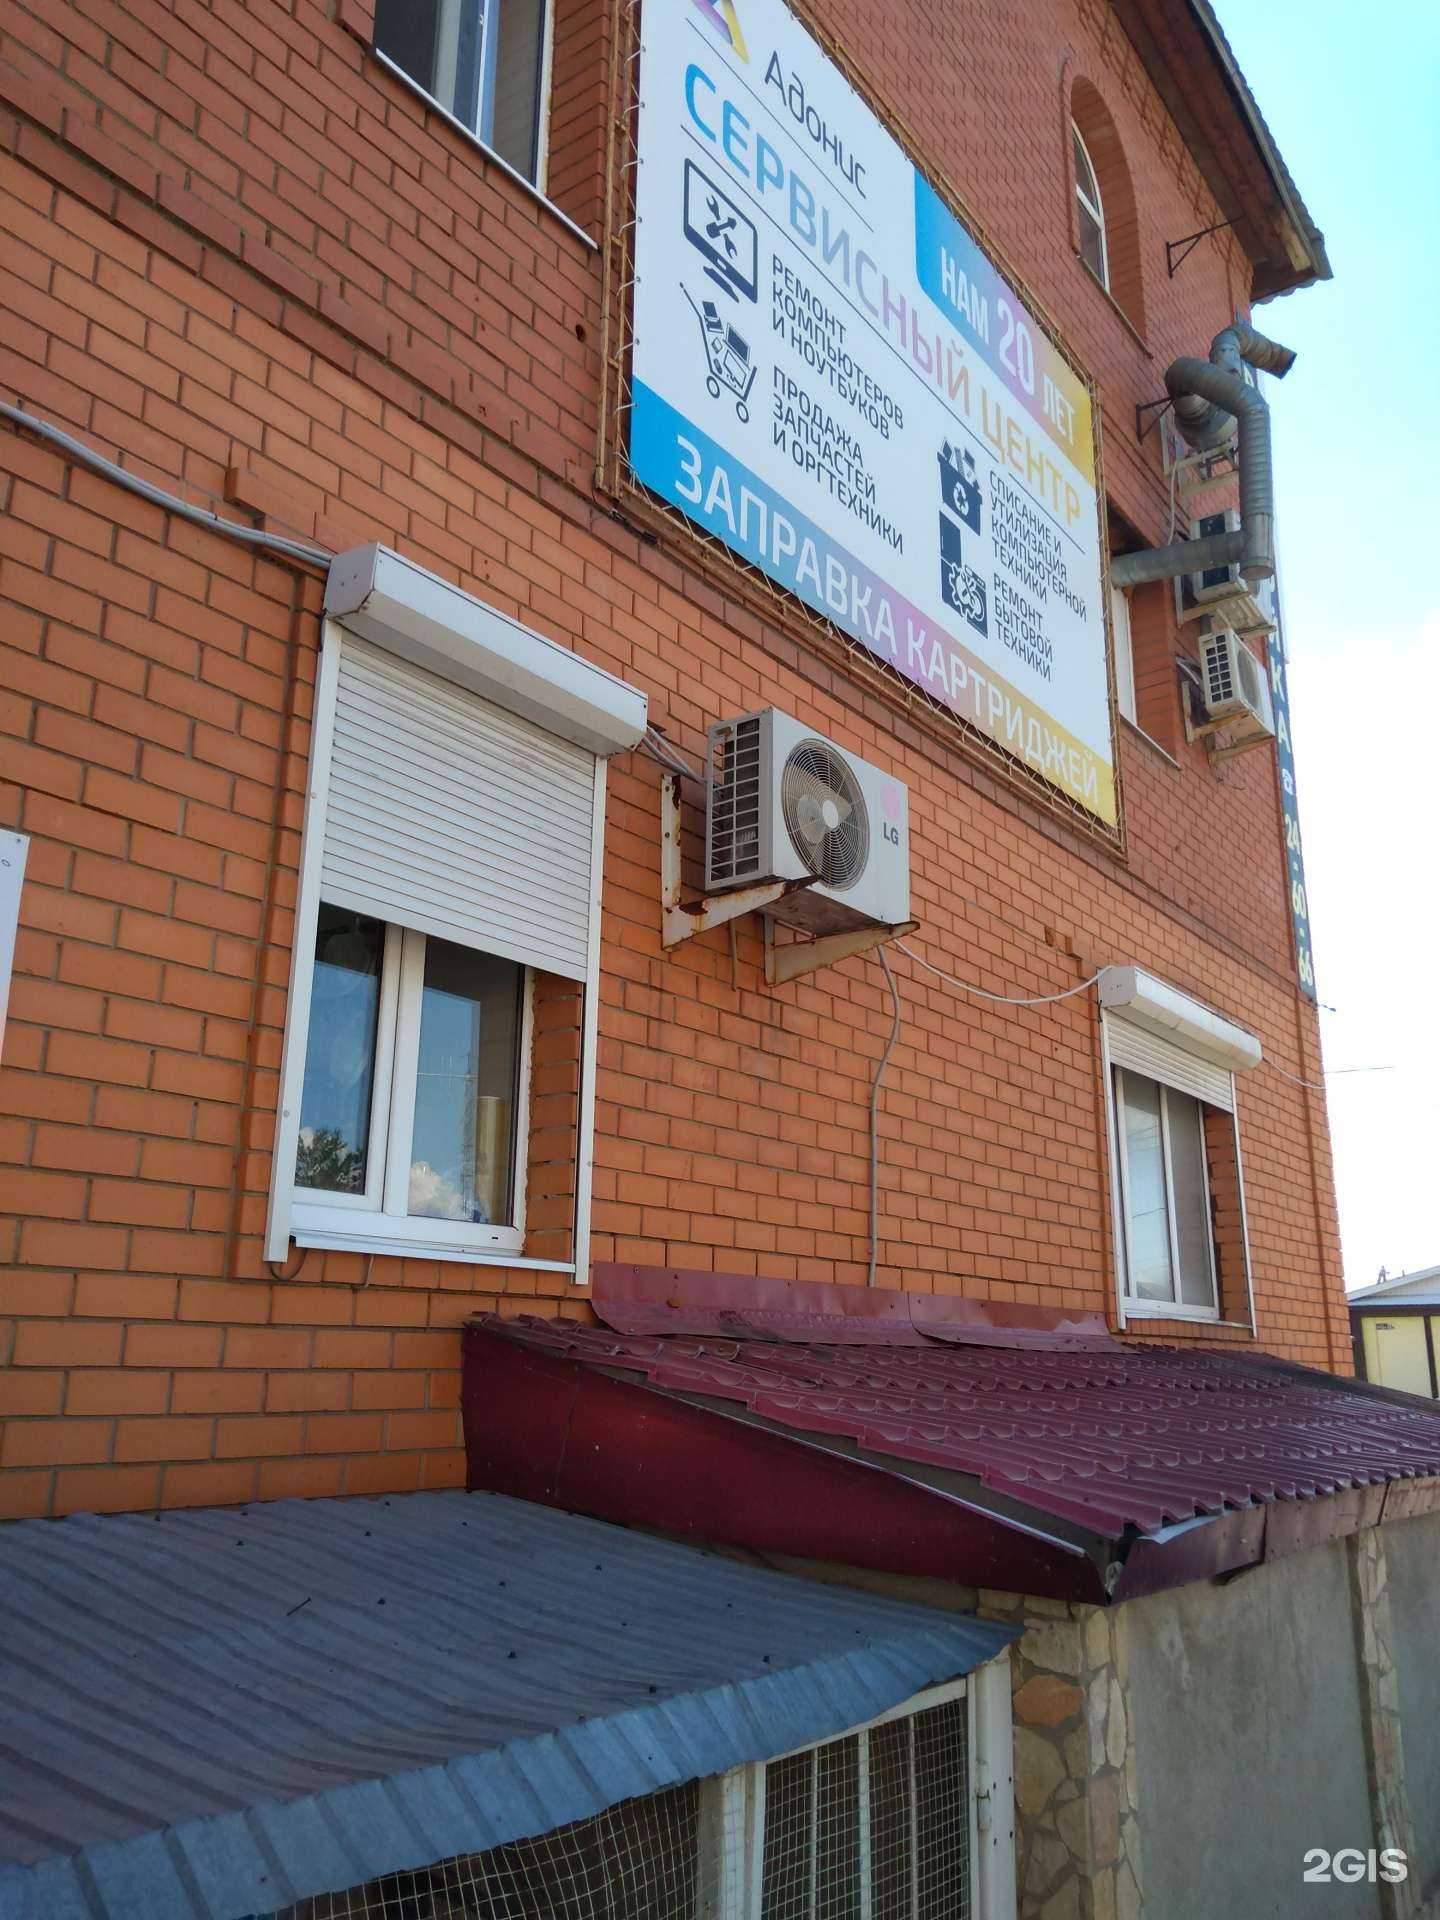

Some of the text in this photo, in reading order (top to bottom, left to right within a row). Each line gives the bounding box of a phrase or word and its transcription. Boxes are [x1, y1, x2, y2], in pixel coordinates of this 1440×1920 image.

[764, 51, 866, 199] Адонис
[685, 63, 1081, 526] СЕРВИСНЫЙ ЦЕНТР
[772, 253, 846, 344] РЕМОНТ
[940, 246, 1075, 447] НАМ 20 ЛЕТ
[772, 280, 904, 430] КОМПЬЮТЕРОВ
[772, 308, 890, 441] И НОУТБУКОВ
[773, 365, 864, 468] ПРОДАЖА
[773, 392, 876, 505] ЗАПЧАСТЕЙ
[773, 421, 903, 555] И ОРГТЕХНИКИ
[989, 469, 1062, 559] СПИСАНИЕ И
[990, 490, 1068, 583] УТИЛИЗАЦИЯ
[674, 434, 1099, 806] ЗАПРАВКА КАРТРИДЖЕЙ
[991, 514, 1087, 623] КОМПЬЮТЕРНОЙ
[991, 536, 1047, 604] ТЕХНИКИ
[993, 572, 1043, 631] РЕМОНТ
[994, 595, 1053, 663] БЫТОВОЙ
[994, 618, 1051, 683] ТЕХНИКИ
[882, 821, 900, 847] LG
